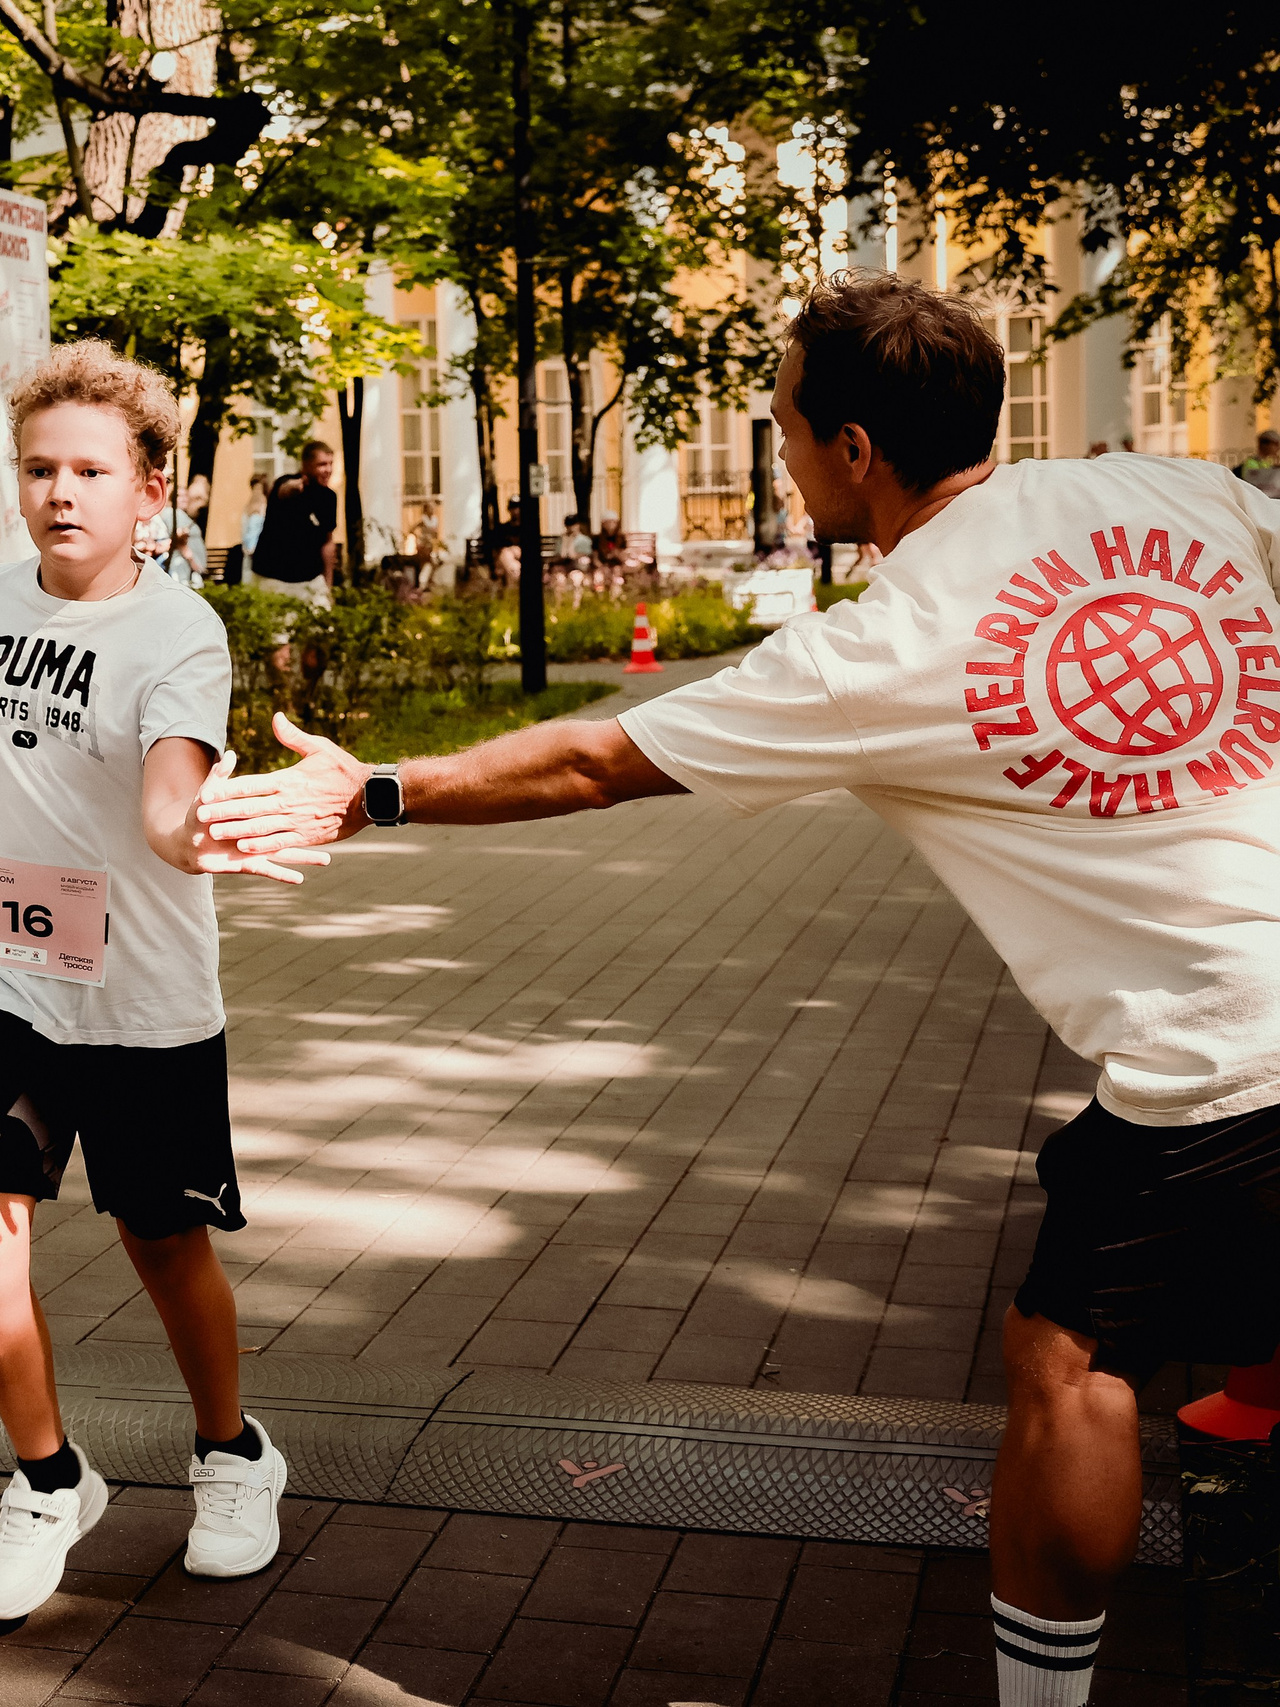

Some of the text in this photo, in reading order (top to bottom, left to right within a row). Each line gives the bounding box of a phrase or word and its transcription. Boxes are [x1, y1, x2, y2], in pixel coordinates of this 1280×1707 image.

[1090, 526, 1244, 599] HALF
[964, 549, 1089, 751] ZELRUN
[1003, 749, 1180, 817] HALF
[67, 877, 98, 886] АВГУСТА
[2, 901, 54, 938] 16
[58, 953, 94, 964] Детская
[63, 961, 93, 972] трасса
[193, 1468, 216, 1478] GSD
